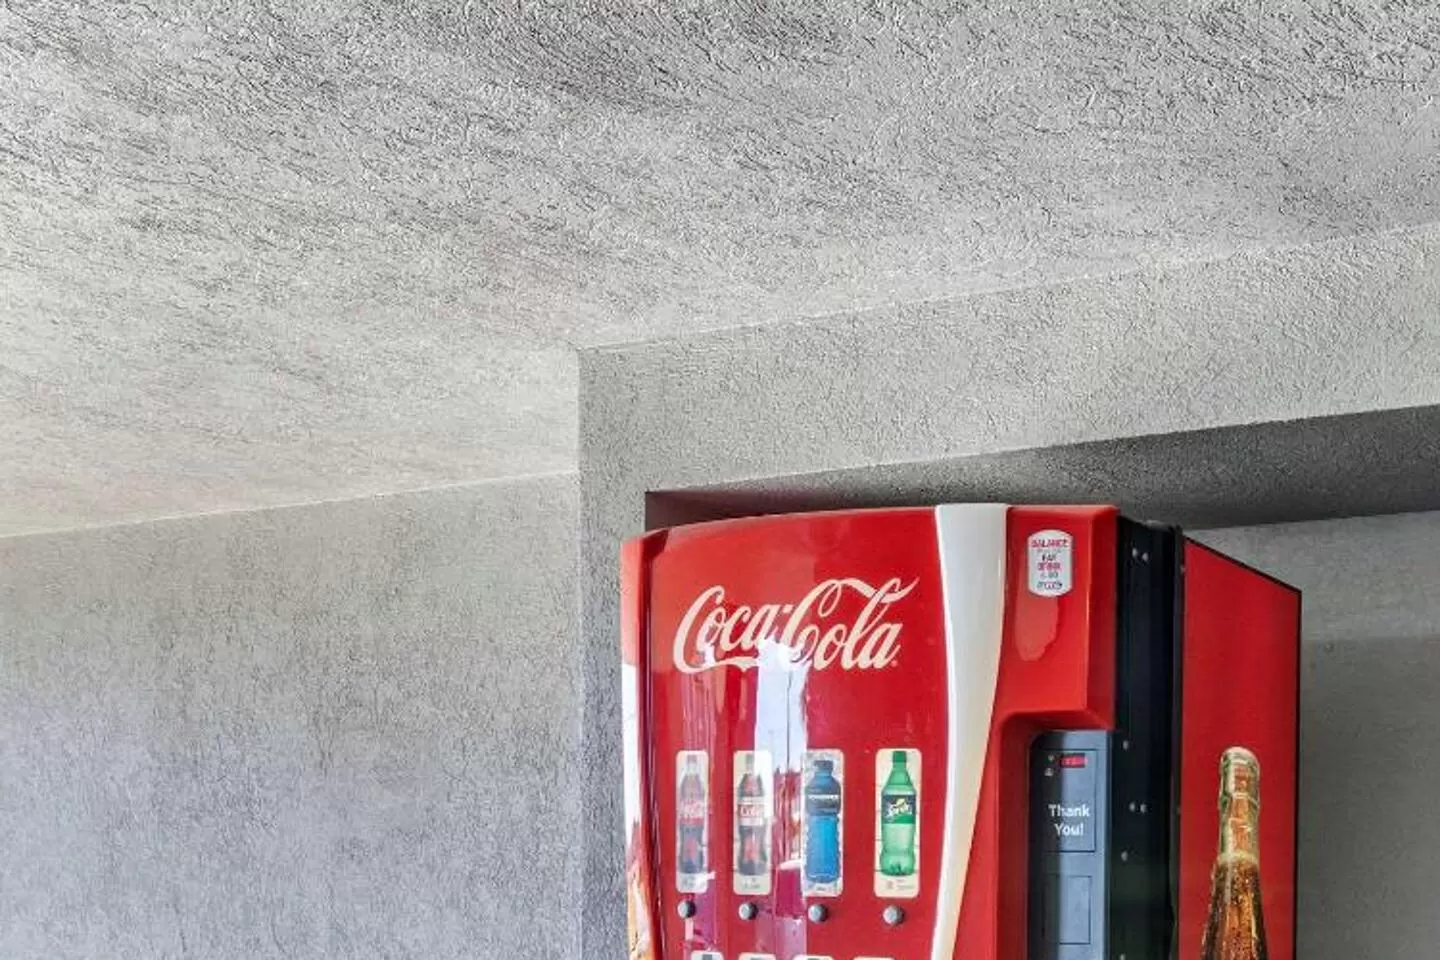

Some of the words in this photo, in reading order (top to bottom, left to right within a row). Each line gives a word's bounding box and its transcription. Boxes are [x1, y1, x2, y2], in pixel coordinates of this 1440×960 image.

[673, 577, 919, 674] Coca-Cola
[1048, 803, 1090, 817] Thank
[1054, 823, 1084, 837] You!
